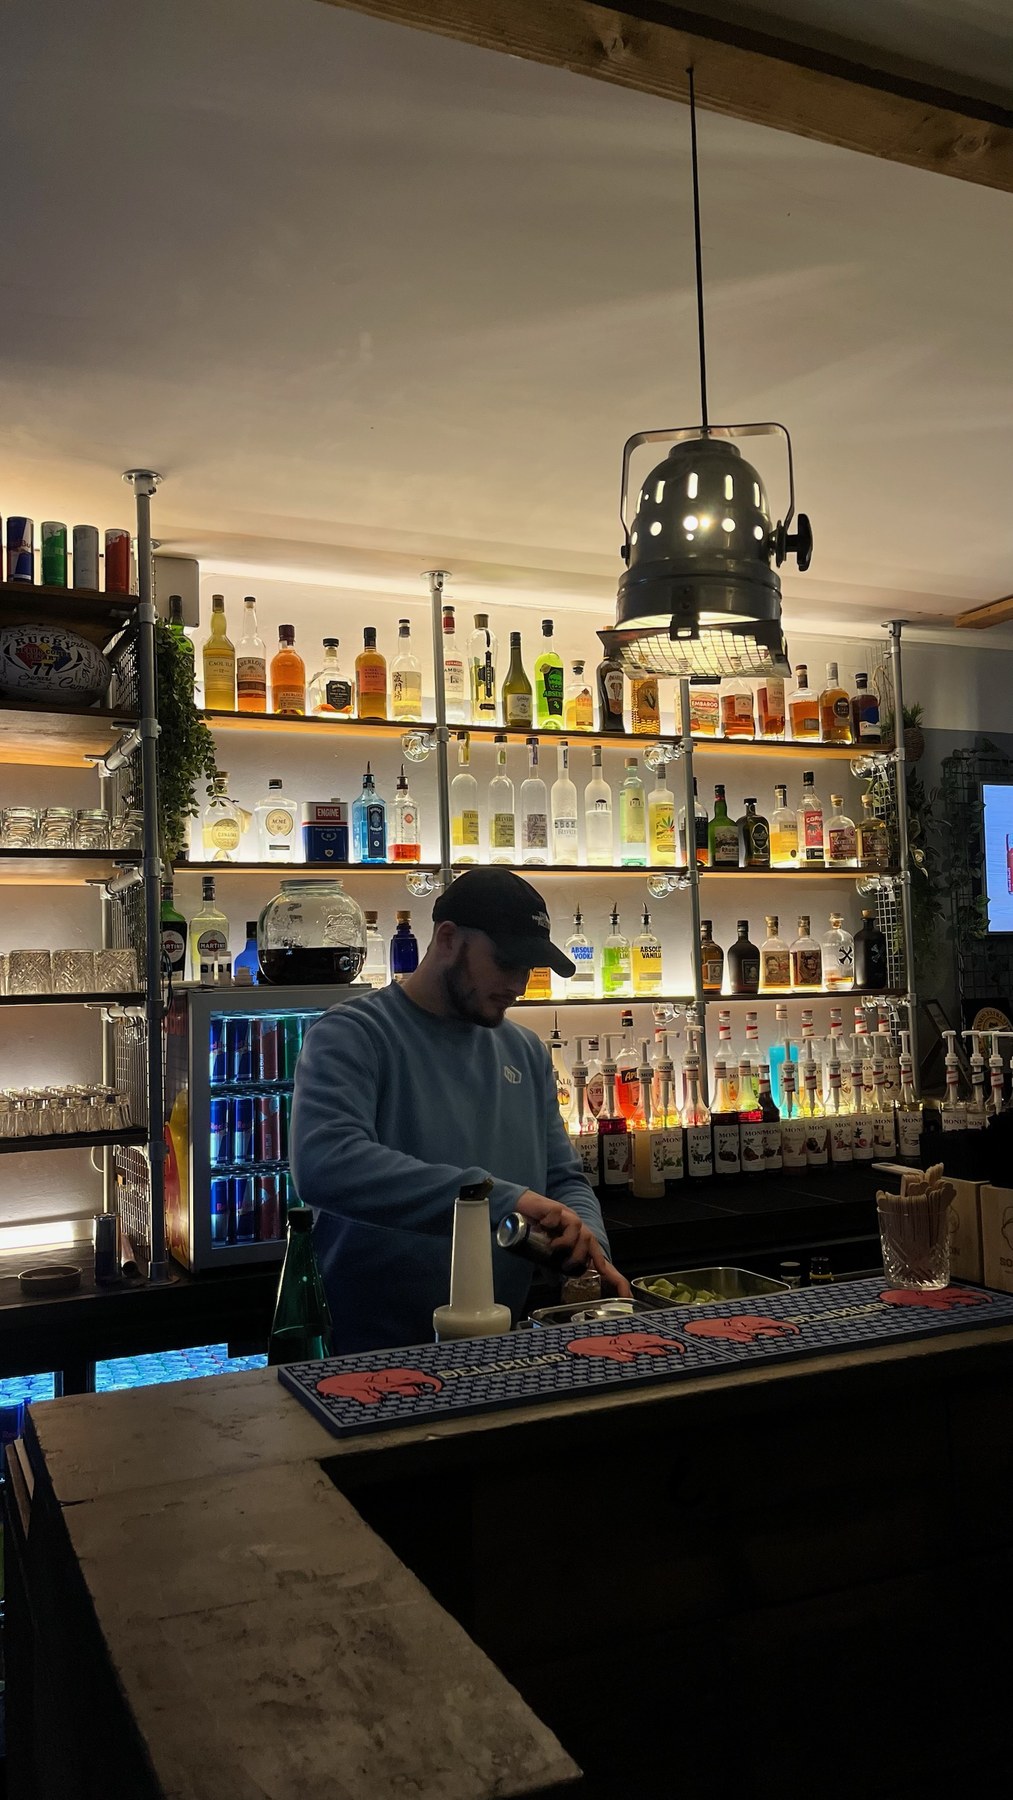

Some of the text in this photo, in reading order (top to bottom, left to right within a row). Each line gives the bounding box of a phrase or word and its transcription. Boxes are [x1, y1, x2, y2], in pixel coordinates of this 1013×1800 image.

[15, 636, 71, 650] RUGBY
[32, 663, 53, 676] 77
[691, 700, 719, 708] EMBARGO
[317, 808, 339, 817] ENGINE
[784, 1302, 894, 1324] DELIRIUM
[437, 1353, 572, 1380] DELIRIUM
